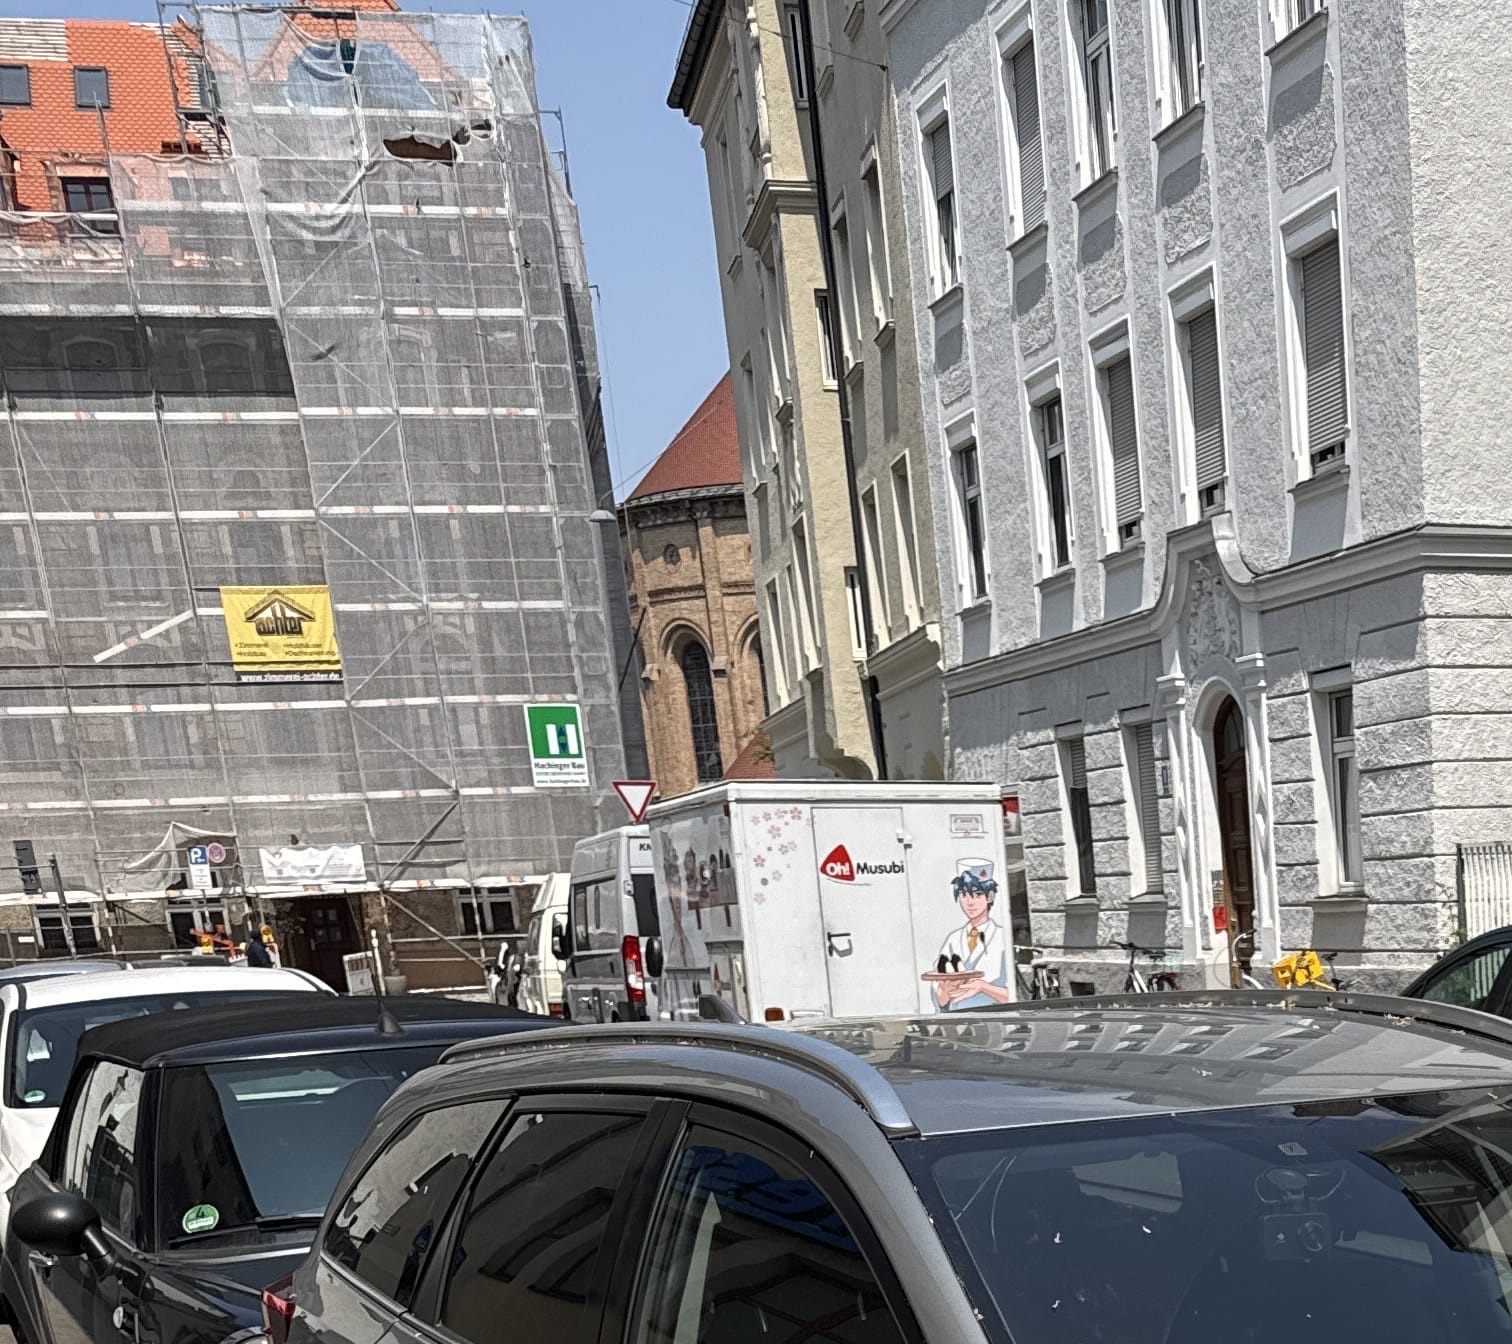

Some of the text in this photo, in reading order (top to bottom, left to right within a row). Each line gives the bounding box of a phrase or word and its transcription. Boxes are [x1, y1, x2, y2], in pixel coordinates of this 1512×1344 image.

[190, 847, 202, 863] P
[825, 860, 905, 876] Oh! Musubi
